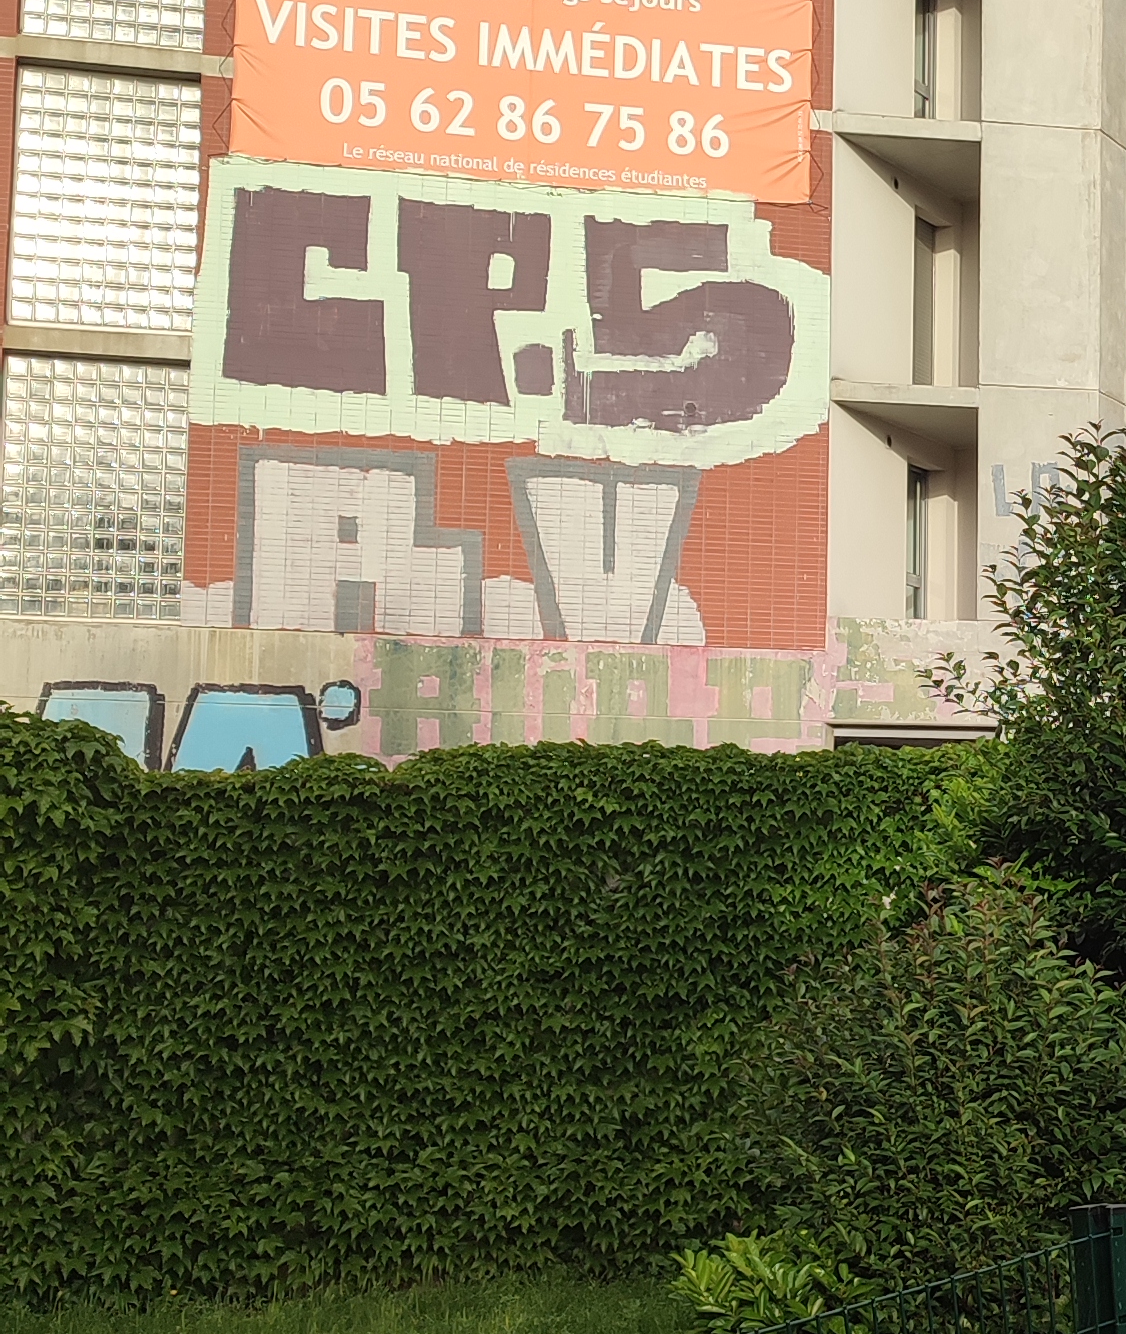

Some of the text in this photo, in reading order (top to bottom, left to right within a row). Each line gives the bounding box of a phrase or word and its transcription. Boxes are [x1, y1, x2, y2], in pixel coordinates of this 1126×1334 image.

[478, 20, 794, 94] IMMÉDIATES
[320, 77, 731, 158] 05 62 86 75 86
[343, 141, 708, 189] Le réseau national de résidences étudiantes
